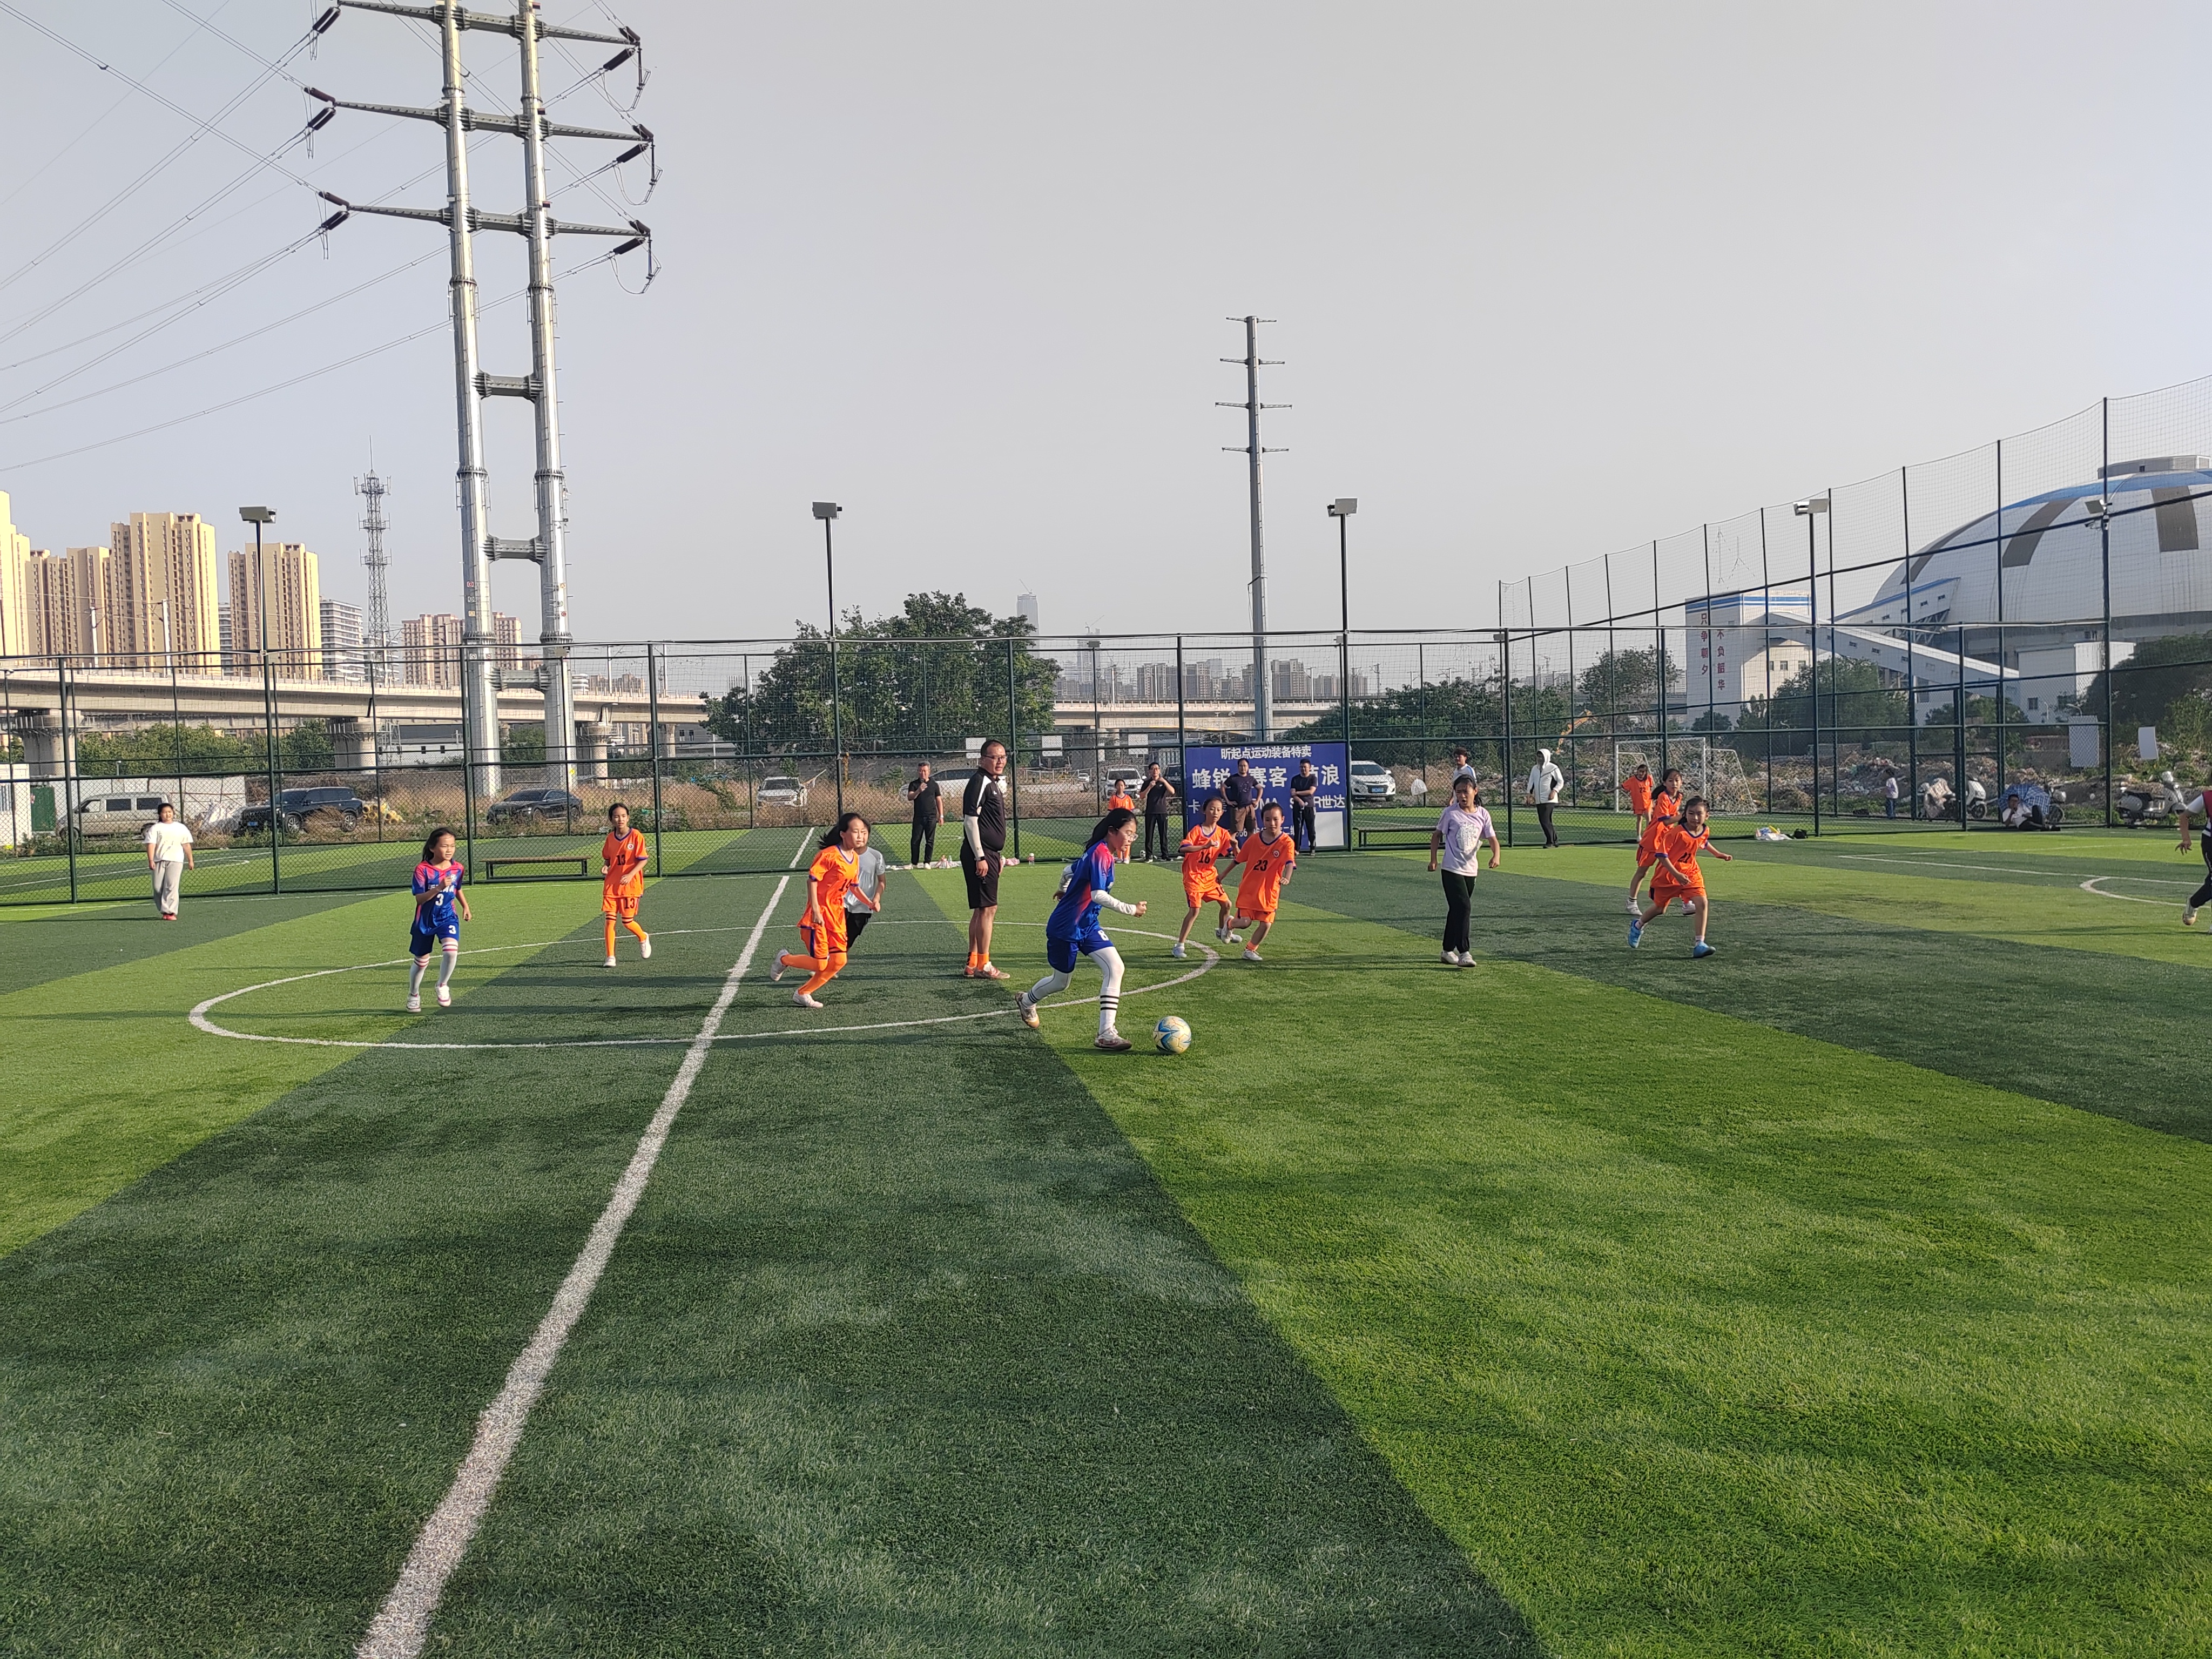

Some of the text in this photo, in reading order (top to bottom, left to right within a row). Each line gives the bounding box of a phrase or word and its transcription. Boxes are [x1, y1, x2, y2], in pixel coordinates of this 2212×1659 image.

[1220, 745, 1312, 760] 昕起点运动装备特卖
[617, 854, 626, 866] 13
[1198, 851, 1211, 864] 16
[1253, 859, 1268, 872] 23
[435, 893, 444, 906] 3
[624, 897, 635, 909] 13
[448, 925, 456, 934] 3
[1098, 929, 1109, 941] 8
